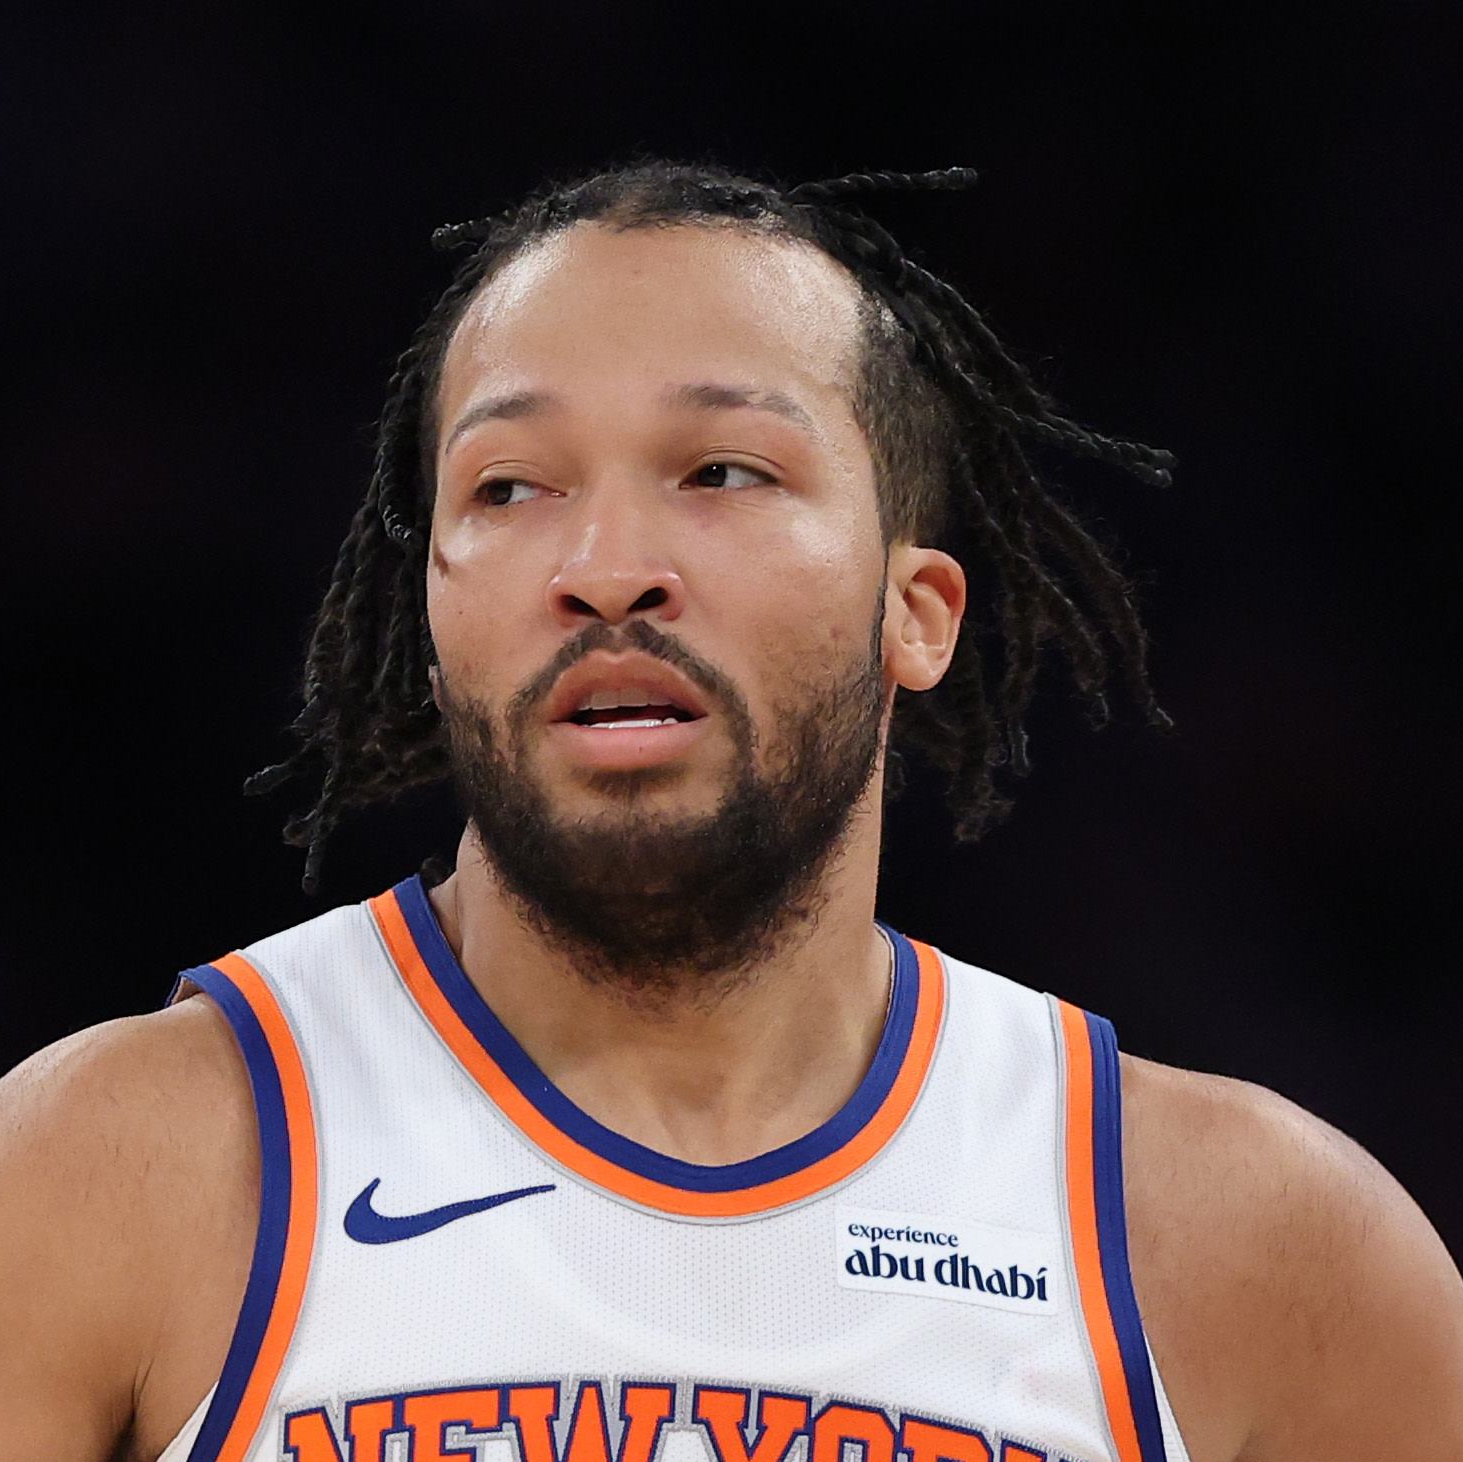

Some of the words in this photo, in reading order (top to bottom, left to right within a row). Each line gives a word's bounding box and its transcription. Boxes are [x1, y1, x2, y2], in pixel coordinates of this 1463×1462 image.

[848, 1223, 958, 1247] experience
[845, 1245, 926, 1282] abu
[934, 1253, 1048, 1301] dhabi
